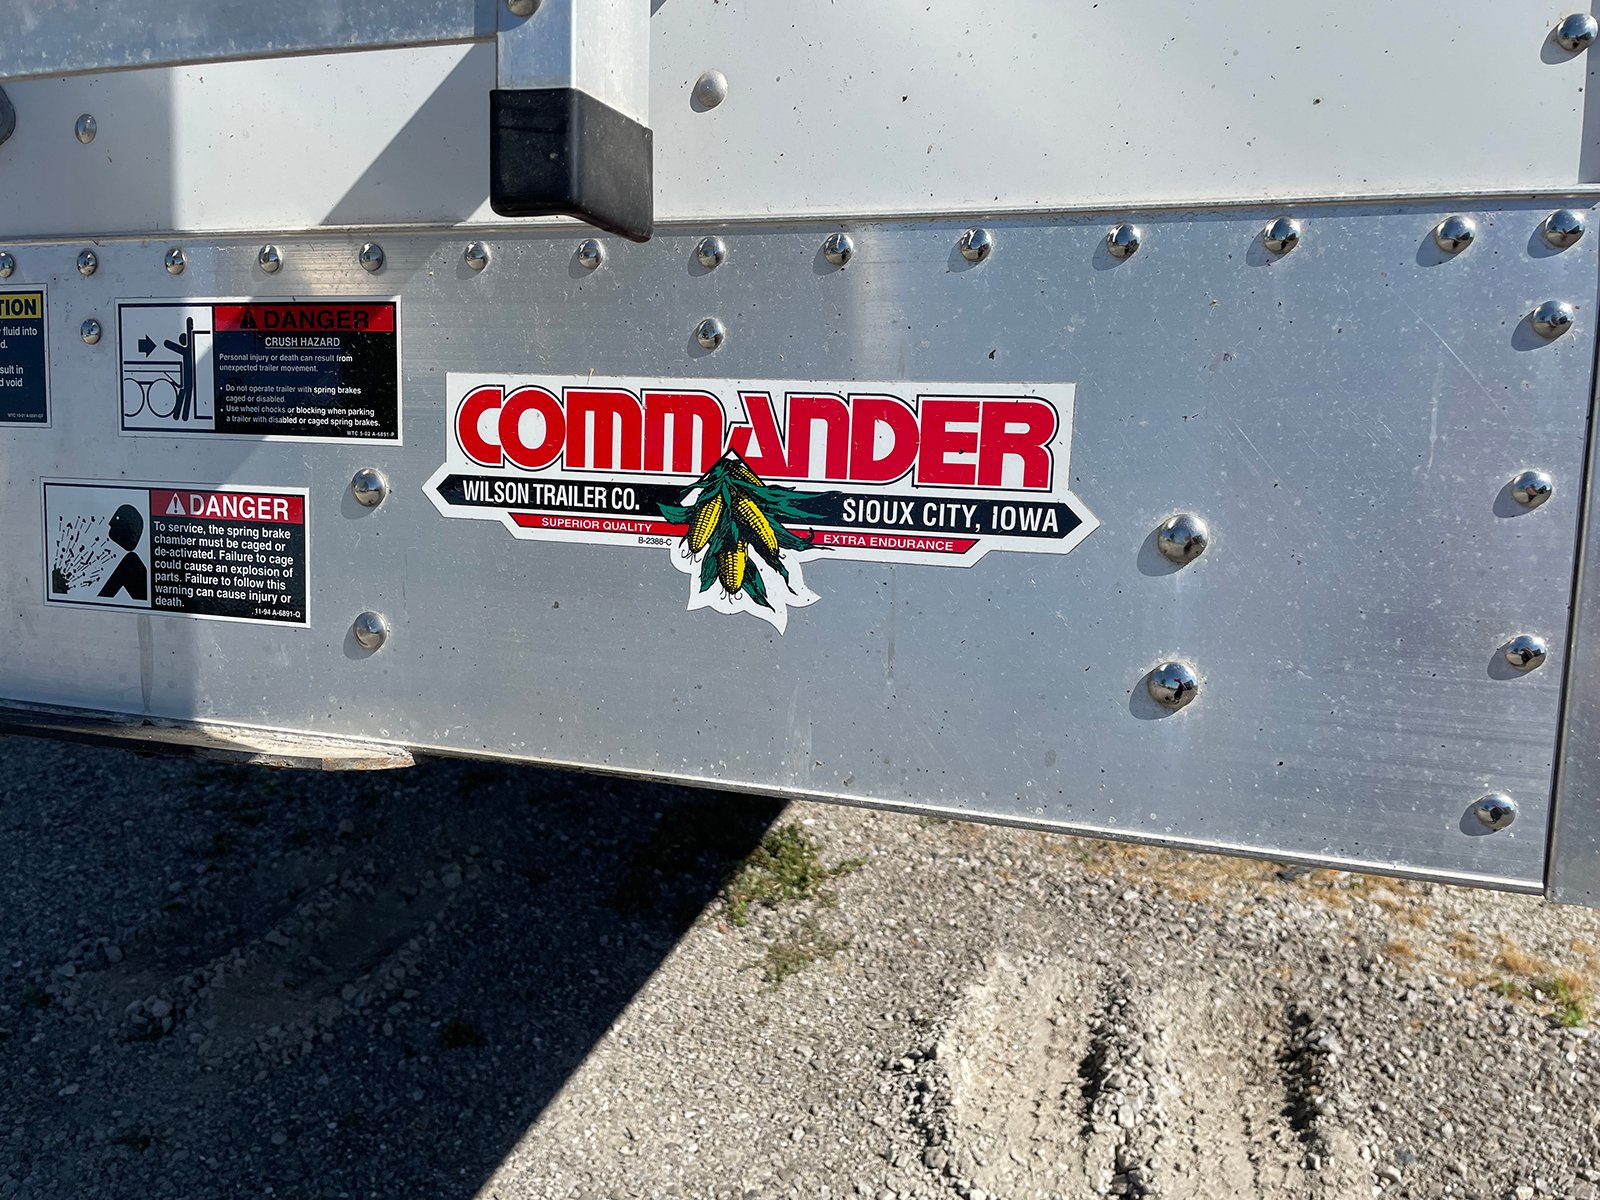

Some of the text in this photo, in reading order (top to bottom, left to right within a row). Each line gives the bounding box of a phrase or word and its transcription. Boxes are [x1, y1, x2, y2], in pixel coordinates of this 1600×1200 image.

[264, 310, 369, 329] DANGER
[3, 326, 38, 336] fluid into
[265, 336, 340, 347] CRUSH HAZARD
[219, 353, 249, 361] Personal
[250, 353, 270, 363] injury
[280, 354, 299, 362] death
[315, 354, 335, 362] result
[336, 354, 353, 362] from
[16, 364, 24, 374] in
[219, 364, 319, 373] unexpected trailer movement.
[6, 377, 23, 387] void
[225, 383, 361, 396] Do not operate trailer with spring brakes
[225, 395, 246, 404] caged
[256, 395, 287, 403] disabled.
[226, 404, 375, 418] Use wheel chocks or blocking when parking
[232, 415, 252, 423] trailer
[253, 415, 267, 423] with
[268, 416, 298, 424] disabled
[308, 417, 329, 427] caged
[330, 418, 353, 428] spring
[354, 418, 381, 427] brakes.
[455, 385, 1060, 490] COMMANDER
[462, 479, 640, 511] WILSON TRAILER CO.
[189, 494, 289, 521] DANGER
[842, 497, 1059, 533] SIOUX CITY, IOWA
[154, 520, 291, 540] To service, the spring brake
[541, 517, 652, 533] SUPERIOR QUALITY
[154, 533, 286, 553] chamber must be caged or
[638, 536, 672, 546] B-2388-C
[823, 534, 954, 552] EXTRA ENDURANCE
[154, 546, 294, 568] de-activated. Failure to cage
[155, 559, 293, 578] could cause an explosion of
[155, 571, 286, 590] parts. Failure to follow this
[155, 584, 292, 605] warning can cause injury or
[155, 596, 185, 607] death.
